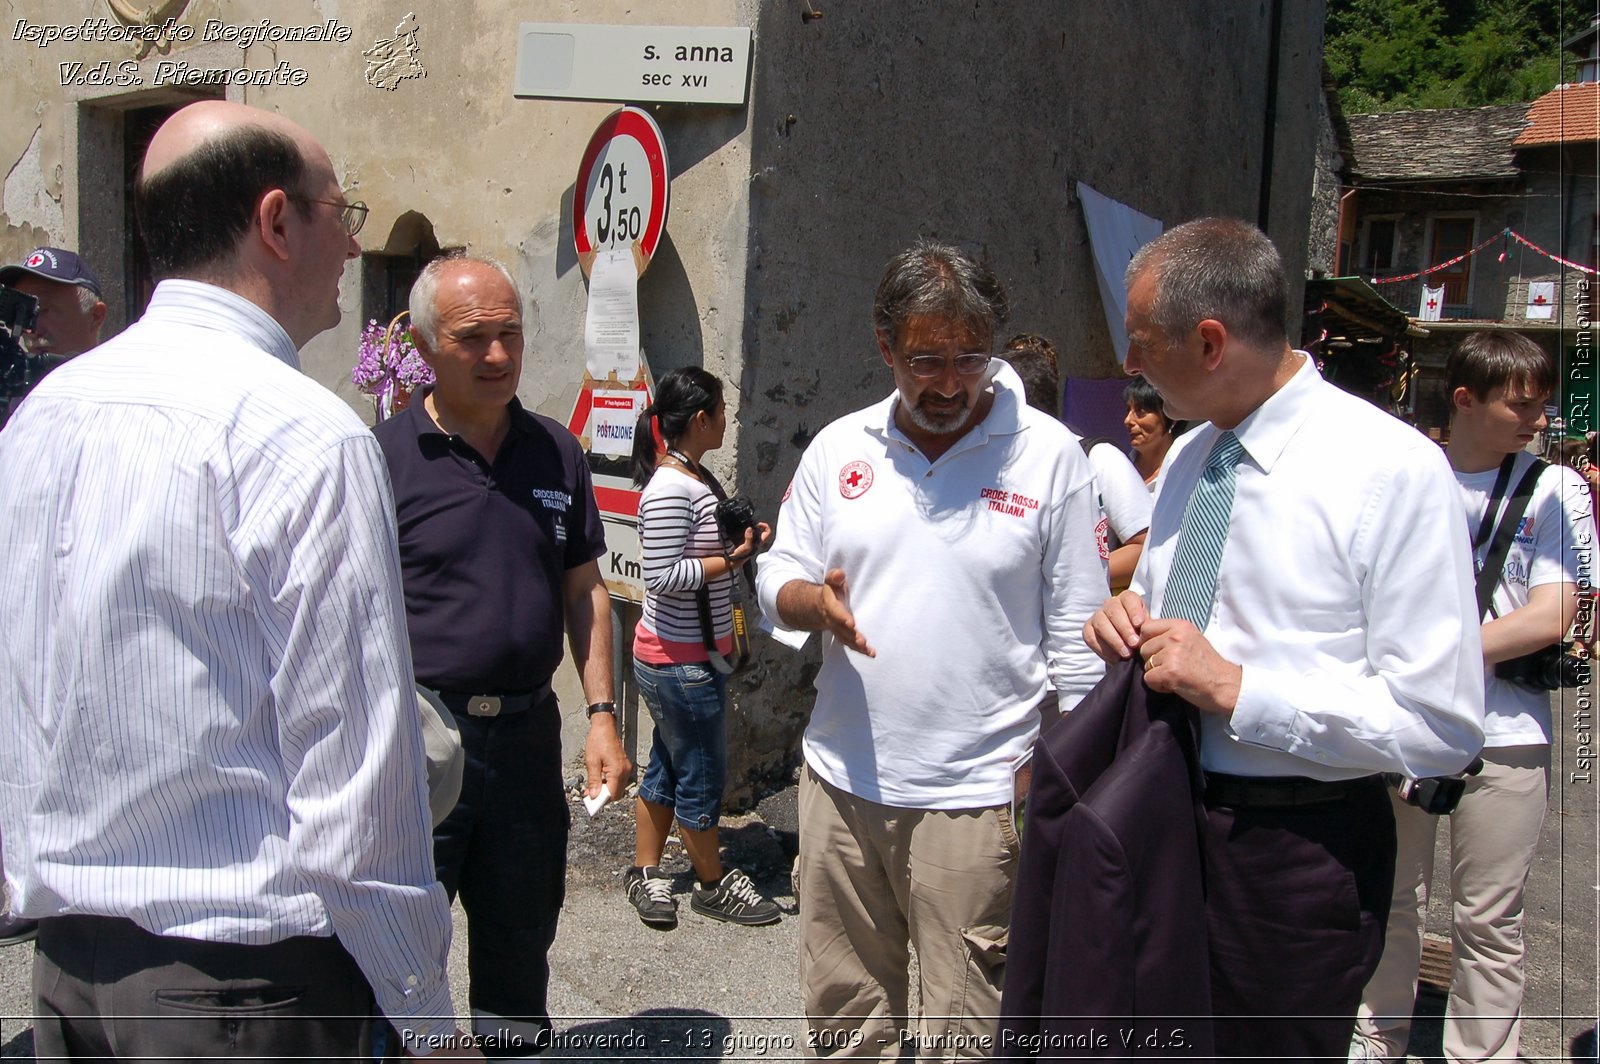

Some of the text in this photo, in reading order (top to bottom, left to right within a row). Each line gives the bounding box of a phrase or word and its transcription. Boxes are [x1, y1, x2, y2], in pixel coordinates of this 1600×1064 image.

[643, 45, 733, 63] s. anna
[642, 73, 672, 86] sec
[597, 424, 633, 440] POSTAZIONE
[532, 489, 555, 499] CROCE
[980, 488, 1039, 510] CROCE ROSSA
[988, 500, 1025, 518] ITALIANA
[611, 551, 641, 579] Km
